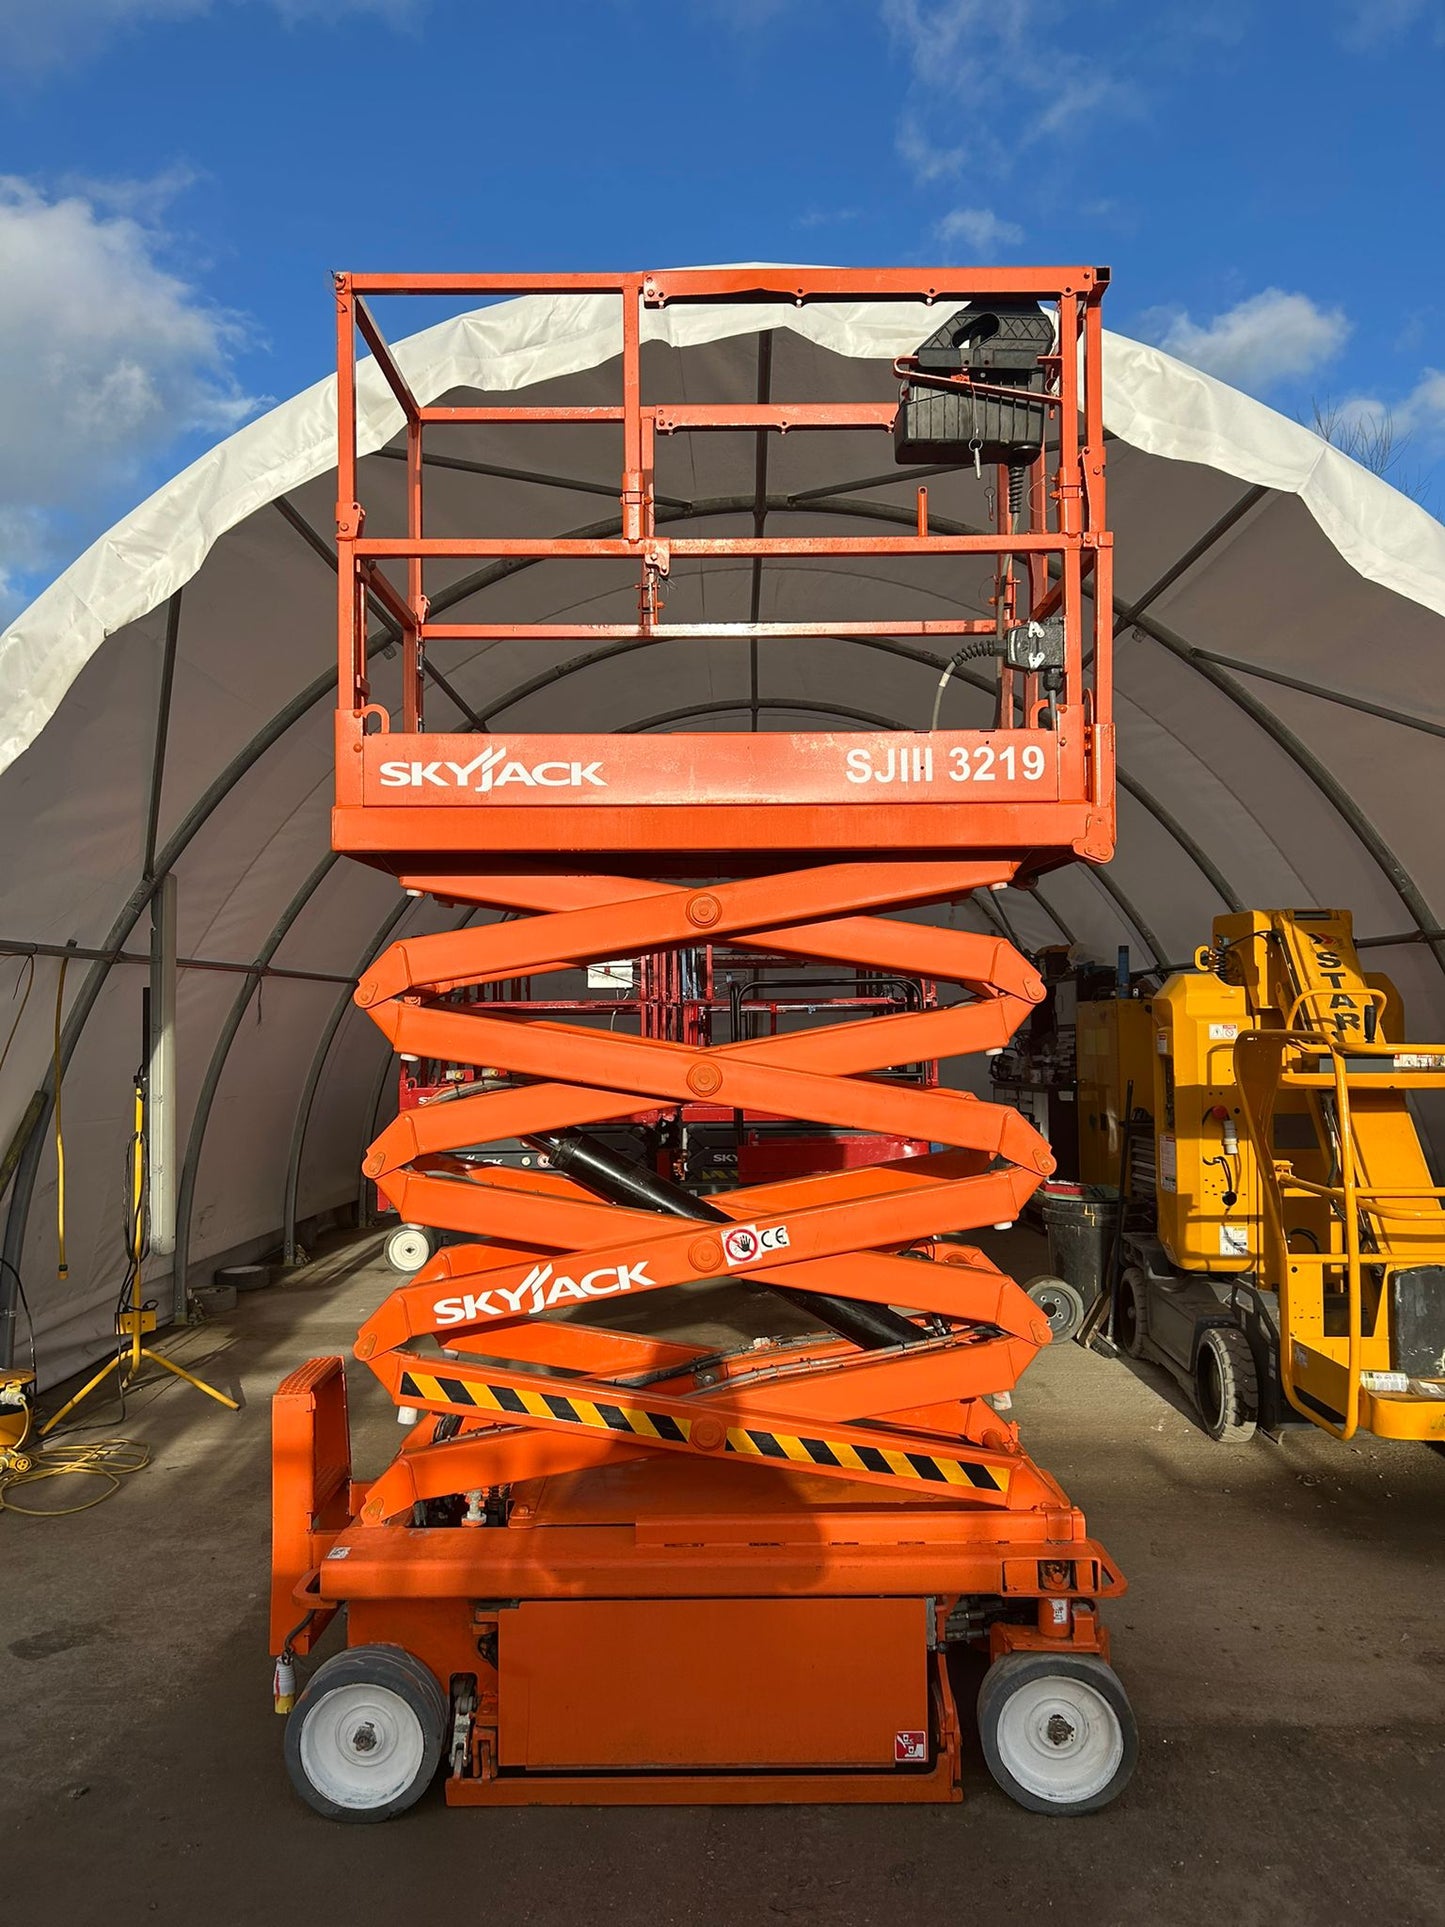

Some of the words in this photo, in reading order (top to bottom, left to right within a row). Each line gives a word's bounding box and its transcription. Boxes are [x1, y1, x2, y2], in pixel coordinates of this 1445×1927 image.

[379, 747, 606, 792] SKYJACK
[845, 747, 933, 783] SJIII
[949, 746, 1045, 782] 3219
[760, 1227, 788, 1248] CE
[434, 1261, 655, 1324] SKYJACK
